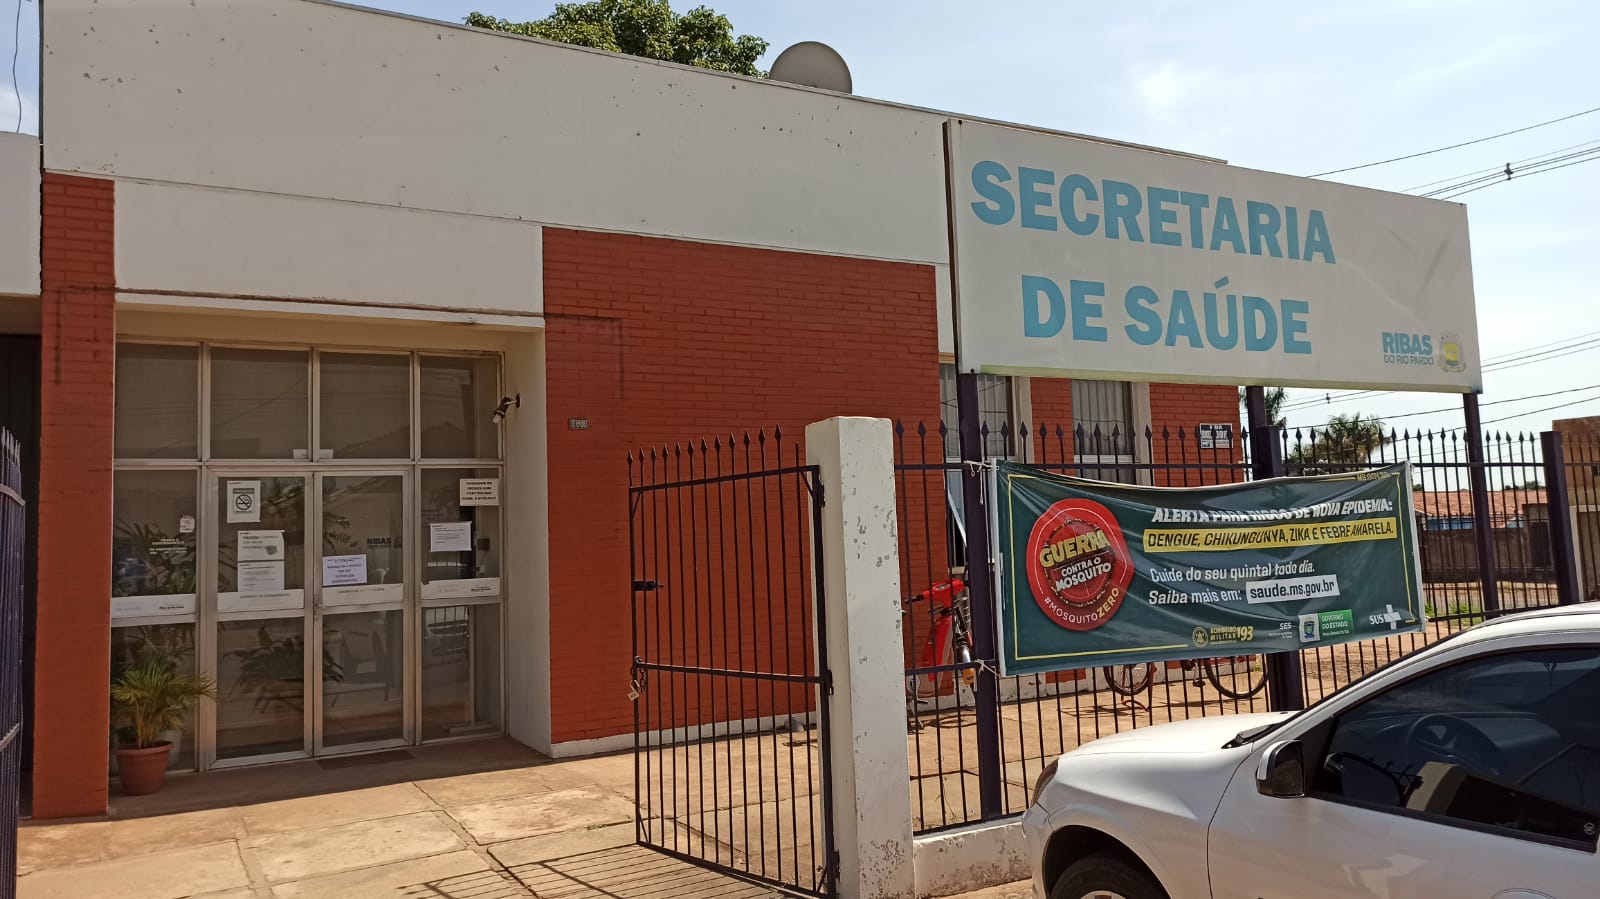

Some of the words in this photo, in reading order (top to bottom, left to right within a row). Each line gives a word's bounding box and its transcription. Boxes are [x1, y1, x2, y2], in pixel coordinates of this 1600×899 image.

[970, 160, 1336, 264] SECRETARIA
[1021, 274, 1108, 342] DE
[1124, 275, 1313, 354] SAÚDE
[1382, 332, 1433, 355] RIBAS
[1384, 354, 1395, 363] DO
[1396, 355, 1409, 364] RIO
[1410, 356, 1434, 365] PARDO
[1152, 506, 1210, 523] ALERTA
[1290, 506, 1311, 518] DE
[1311, 502, 1341, 518] NOVA
[1341, 498, 1393, 514] EPIDEMIA:
[1148, 533, 1201, 547] DENGUE,
[1203, 529, 1289, 546] CHIKUNGUNYA,
[1290, 528, 1311, 542] ZIKA
[1312, 528, 1319, 540] E
[1320, 525, 1351, 539] FEBRE
[1351, 521, 1394, 536] AMARELA.
[1040, 530, 1111, 567] GUERRA
[1055, 562, 1112, 591] MOSQUITO
[1061, 560, 1093, 577] CONTRA
[1093, 557, 1102, 565] O
[1150, 567, 1183, 583] Cuide
[1186, 566, 1202, 581] do
[1205, 568, 1227, 580] seu
[1230, 562, 1272, 582] quintal
[1274, 562, 1297, 576] todo
[1299, 560, 1315, 573] dia.
[1149, 590, 1188, 604] Saiba
[1191, 590, 1219, 603] mais
[1221, 590, 1242, 602] em:
[1250, 579, 1335, 599] saude.ms.gov.br
[1279, 622, 1292, 630] SES
[1329, 621, 1349, 629] ESTADO
[1369, 614, 1384, 625] SUS
[1210, 632, 1237, 641] MILITAR
[1237, 625, 1254, 641] 193
